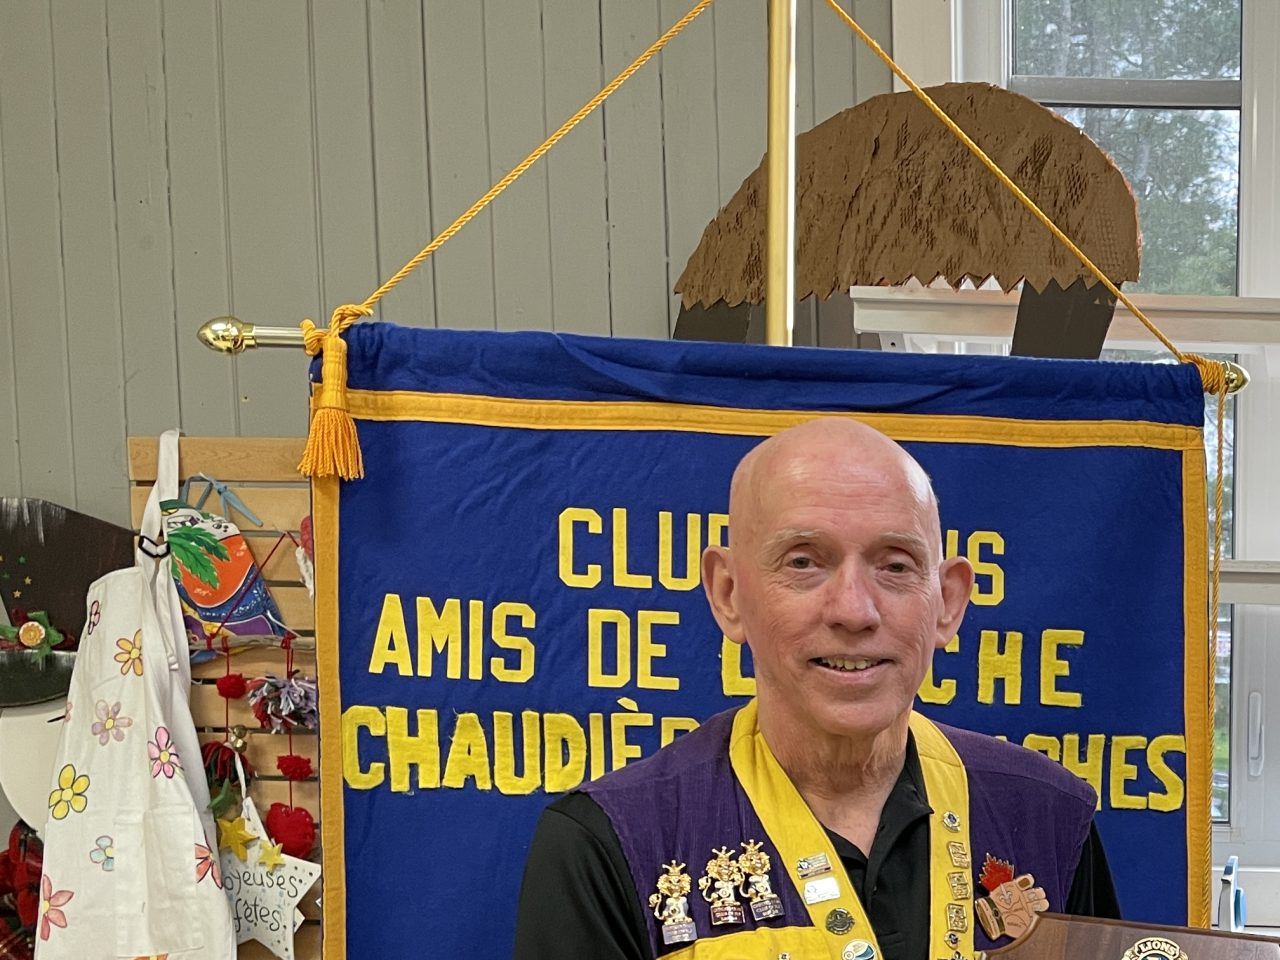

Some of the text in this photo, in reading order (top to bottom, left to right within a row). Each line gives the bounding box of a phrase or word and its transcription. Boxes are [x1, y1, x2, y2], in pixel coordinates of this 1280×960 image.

[368, 593, 536, 684] AMIS
[588, 608, 680, 691] DE
[222, 870, 298, 899] oyeuses
[233, 896, 280, 933] fêtes
[1138, 940, 1177, 956] LIONS
